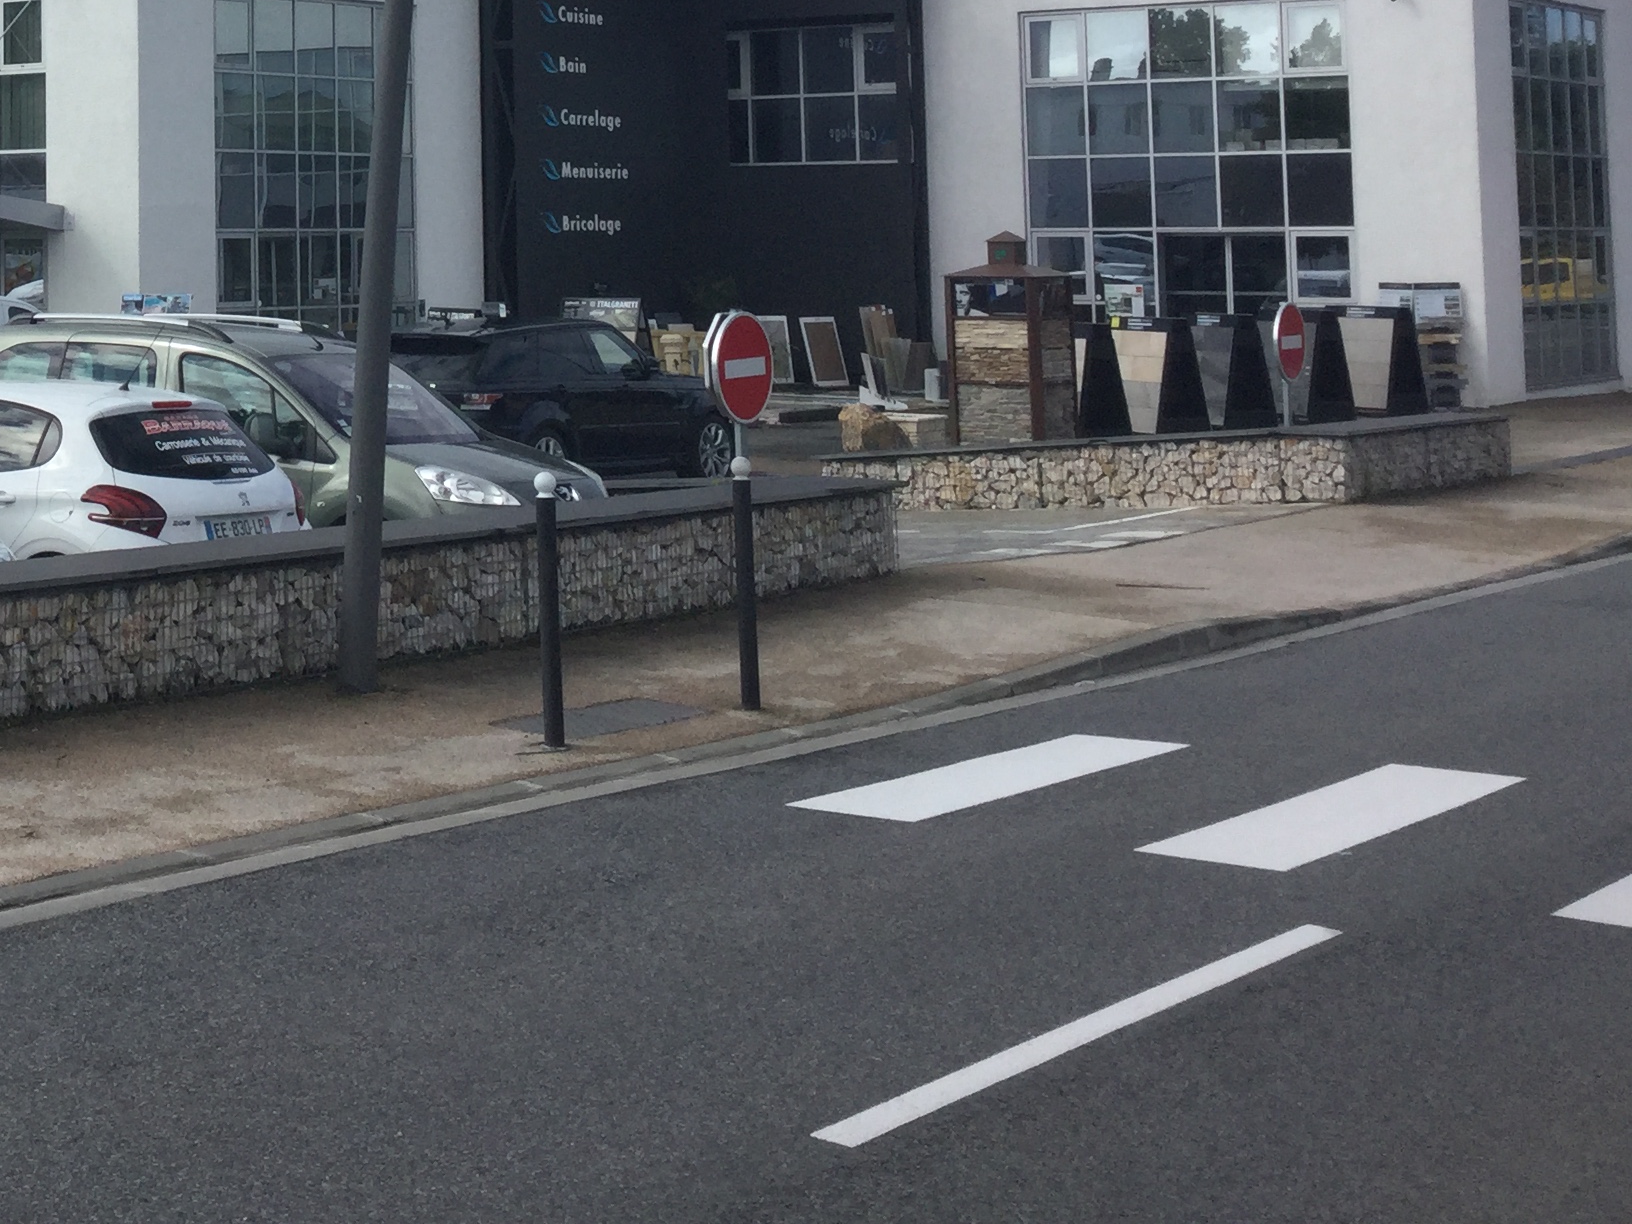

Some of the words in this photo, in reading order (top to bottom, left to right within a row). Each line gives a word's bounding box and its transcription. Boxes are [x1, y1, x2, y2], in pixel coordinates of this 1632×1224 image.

[558, 5, 604, 26] Cuisine
[559, 56, 587, 74] Bain
[560, 108, 622, 132] Carrelage
[561, 161, 629, 180] Menuiserie
[562, 214, 622, 236] Bricolage
[154, 437, 201, 452] Carrosserie
[213, 518, 265, 539] EE-830-LP
